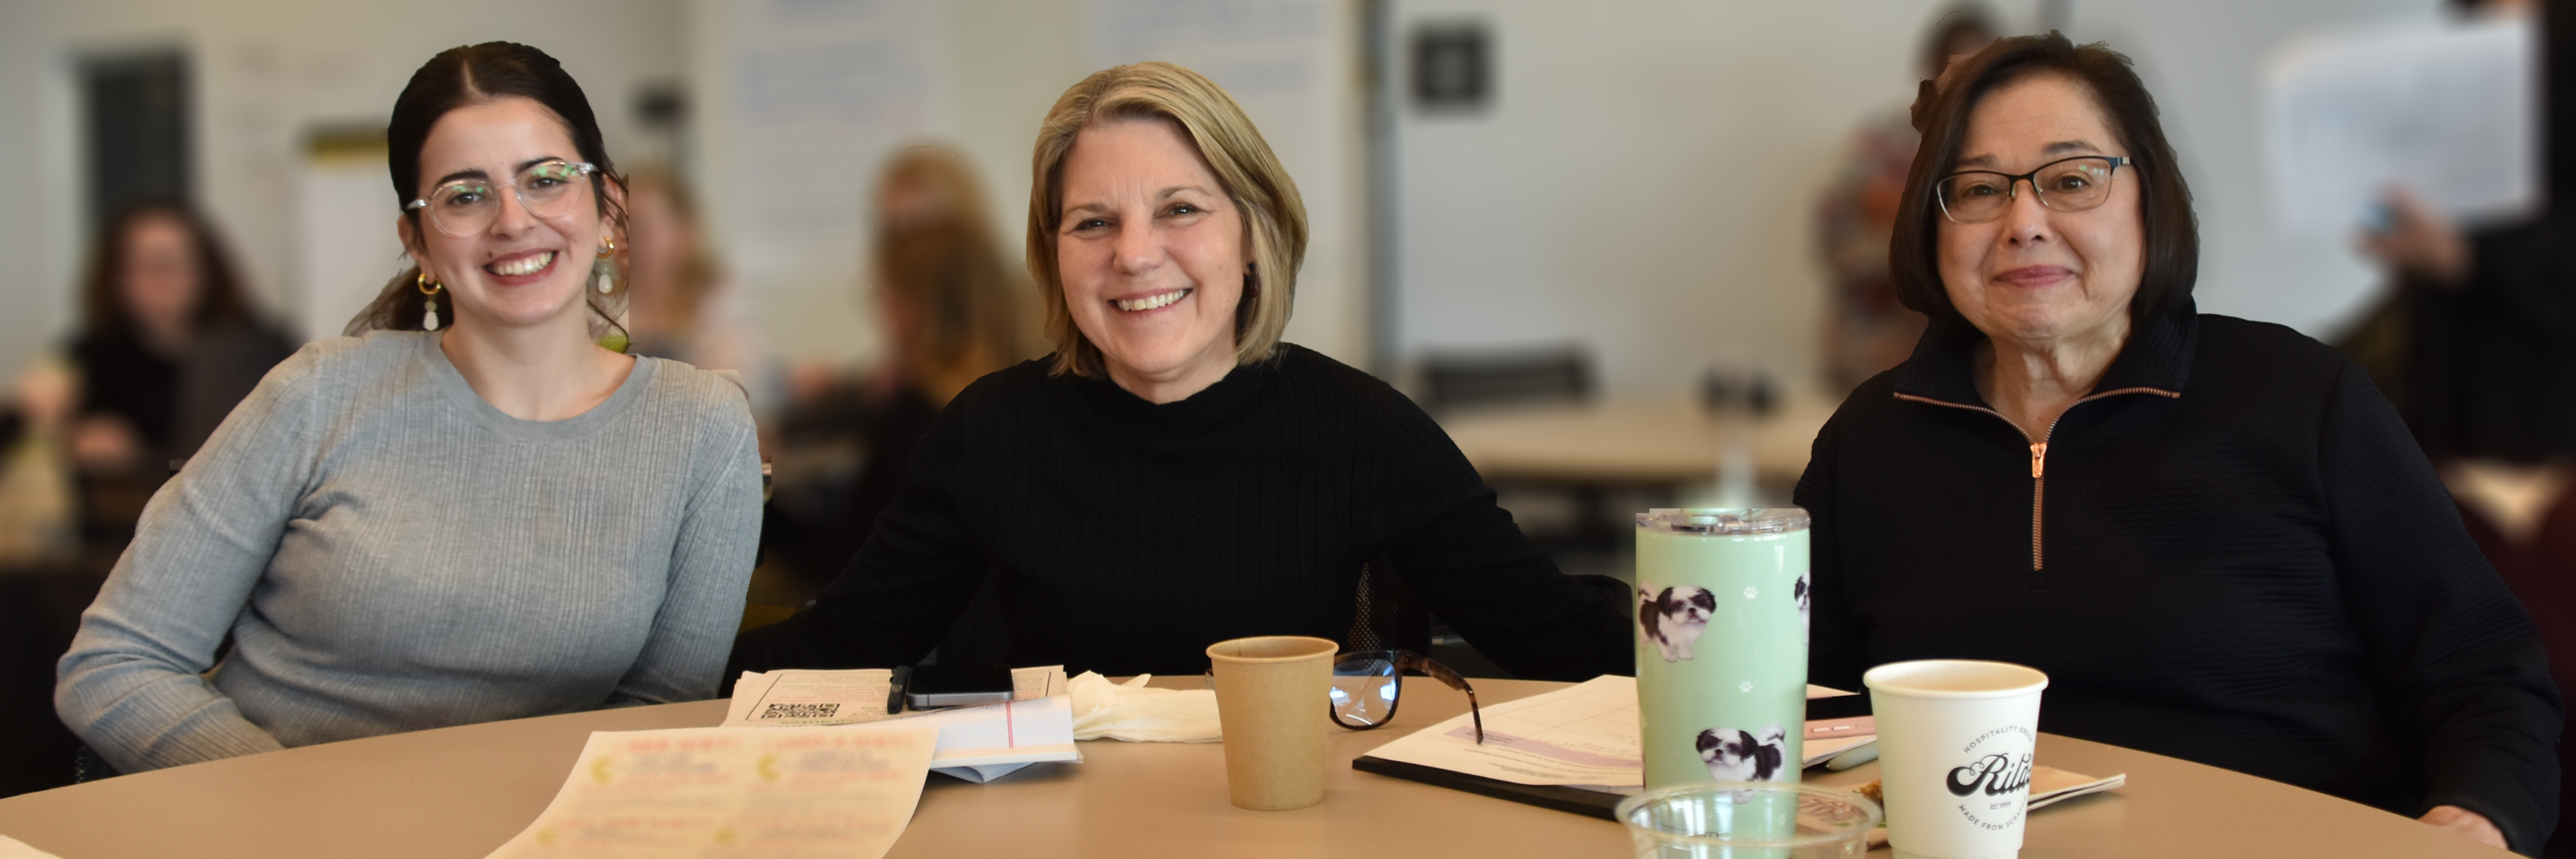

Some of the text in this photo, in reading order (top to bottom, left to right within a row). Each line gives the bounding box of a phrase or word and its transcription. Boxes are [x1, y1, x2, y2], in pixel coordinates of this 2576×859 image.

[1963, 725, 2017, 754] HOSPITALITY
[1958, 805, 1980, 826] MADE
[1981, 822, 2004, 831] FROM
